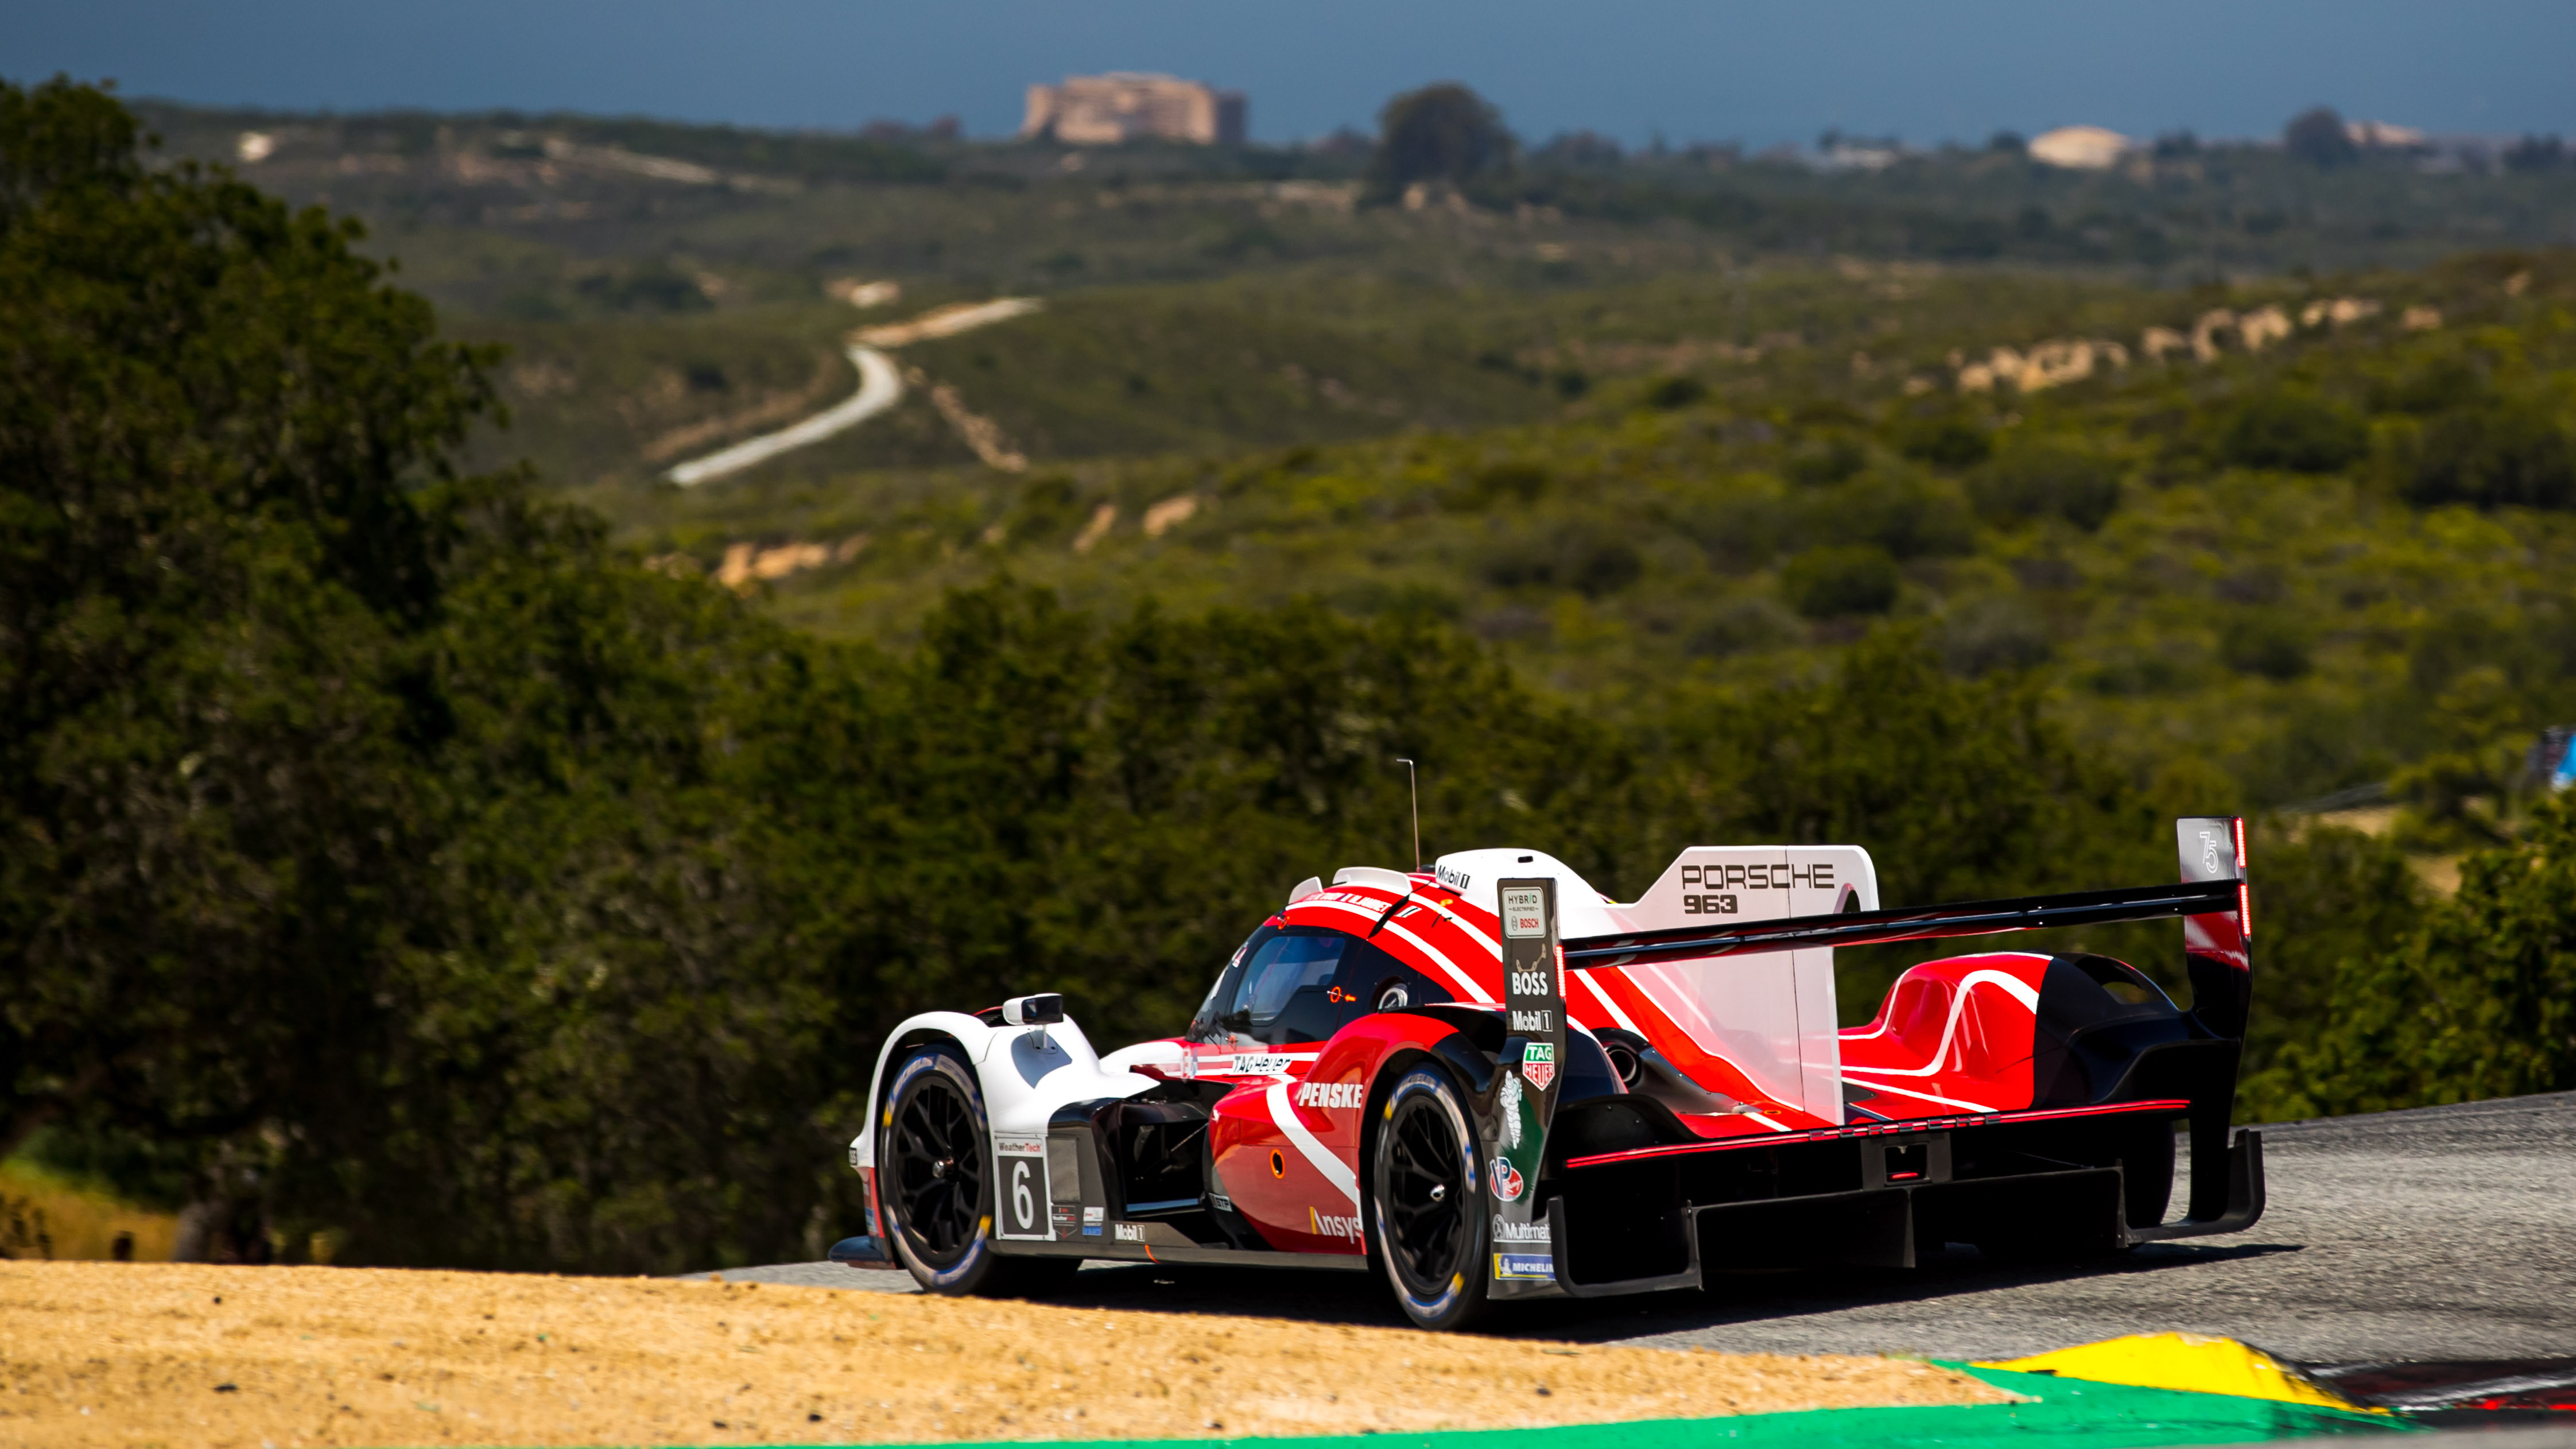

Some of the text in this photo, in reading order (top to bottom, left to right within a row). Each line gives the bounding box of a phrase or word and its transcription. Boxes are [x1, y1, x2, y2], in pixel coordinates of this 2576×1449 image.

[1436, 865, 1461, 886] Mobil
[1681, 864, 1835, 889] PORSCHE
[1508, 893, 1538, 904] HYBRID
[1683, 894, 1738, 914] 963
[1520, 918, 1539, 928] BOSCH
[1512, 971, 1549, 995] BOSS
[1512, 1010, 1542, 1031] Mobil
[1528, 1046, 1553, 1060] TAG
[1524, 1064, 1553, 1087] HEUER
[1298, 1082, 1363, 1109] PENSKE
[999, 1142, 1042, 1153] WeatherTech
[1012, 1160, 1034, 1230] 6
[1115, 1223, 1138, 1241] Mobil
[1309, 1206, 1361, 1244] Ansys
[1505, 1222, 1551, 1240] Multimat
